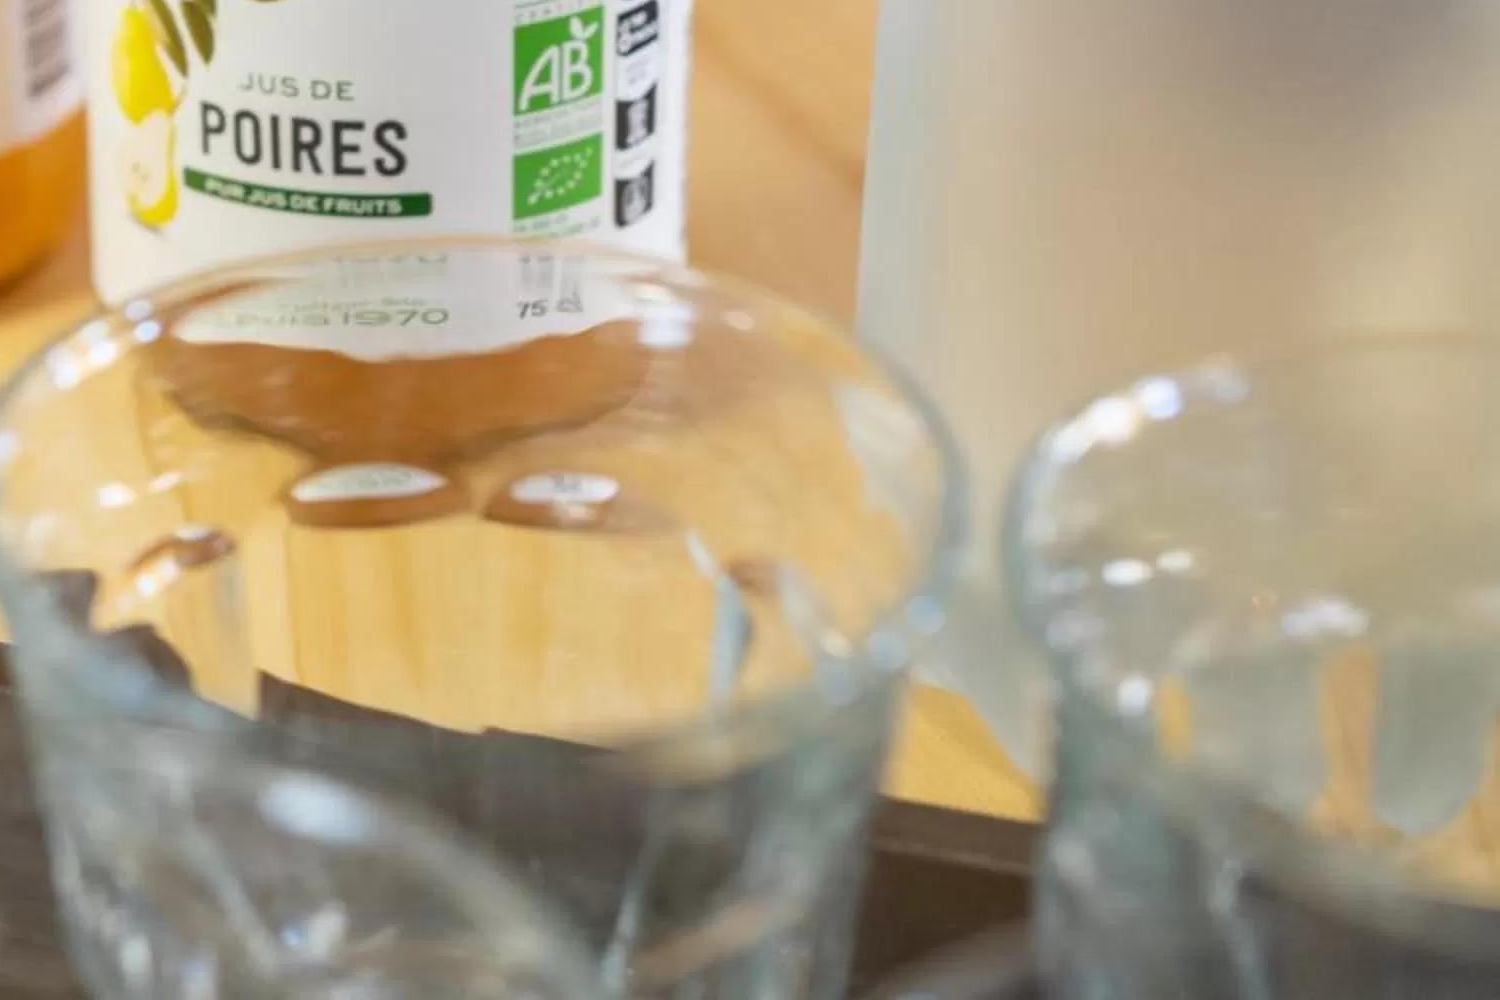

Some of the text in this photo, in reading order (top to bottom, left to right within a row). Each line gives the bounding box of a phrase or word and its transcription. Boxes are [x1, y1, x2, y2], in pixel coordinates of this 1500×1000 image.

[240, 73, 355, 101] JUS DE
[517, 38, 594, 112] AB
[200, 100, 408, 178] POIRES
[204, 177, 403, 217] PUR JUS DE FRUITS
[515, 298, 549, 320] 75
